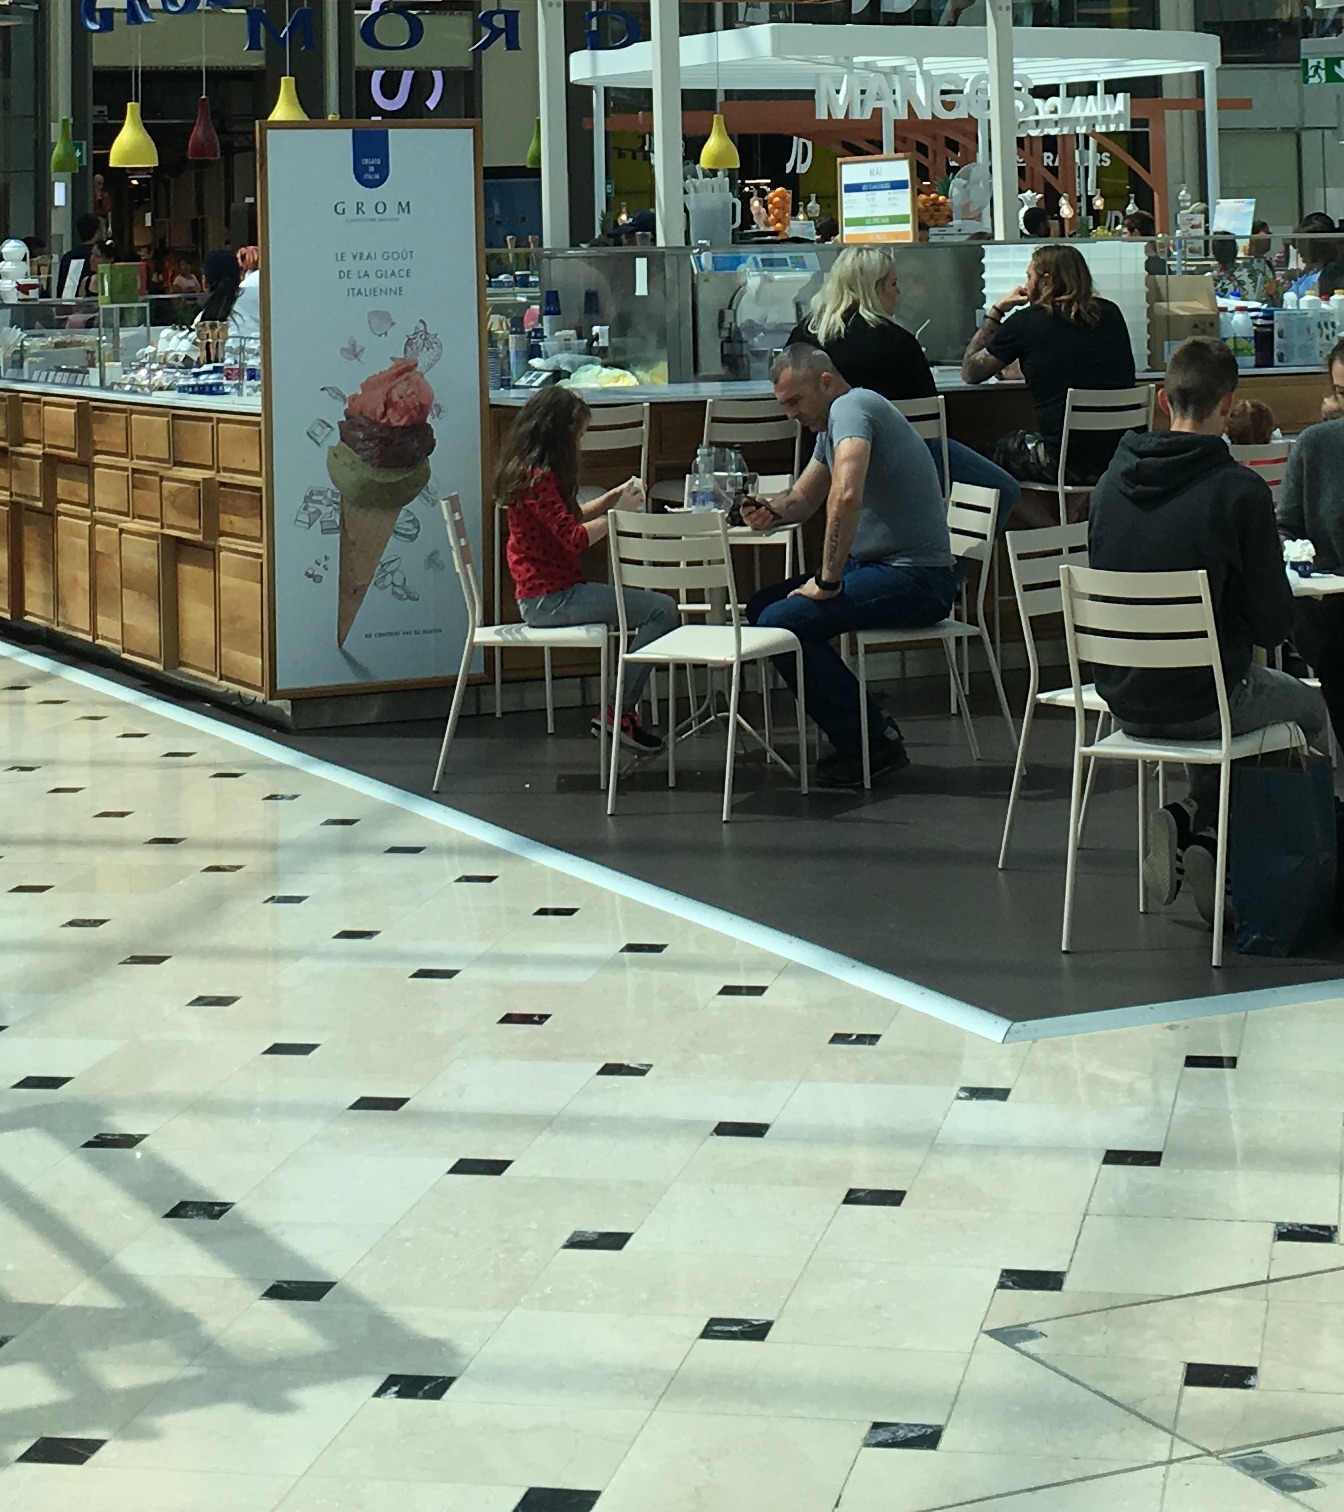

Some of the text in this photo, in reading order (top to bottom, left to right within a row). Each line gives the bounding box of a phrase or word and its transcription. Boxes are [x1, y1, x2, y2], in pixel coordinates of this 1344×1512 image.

[334, 200, 411, 216] GROM
[335, 248, 414, 262] LE VRAI GOÛT
[338, 268, 412, 280] DE LA GLACE
[346, 286, 404, 297] ITALIENNE
